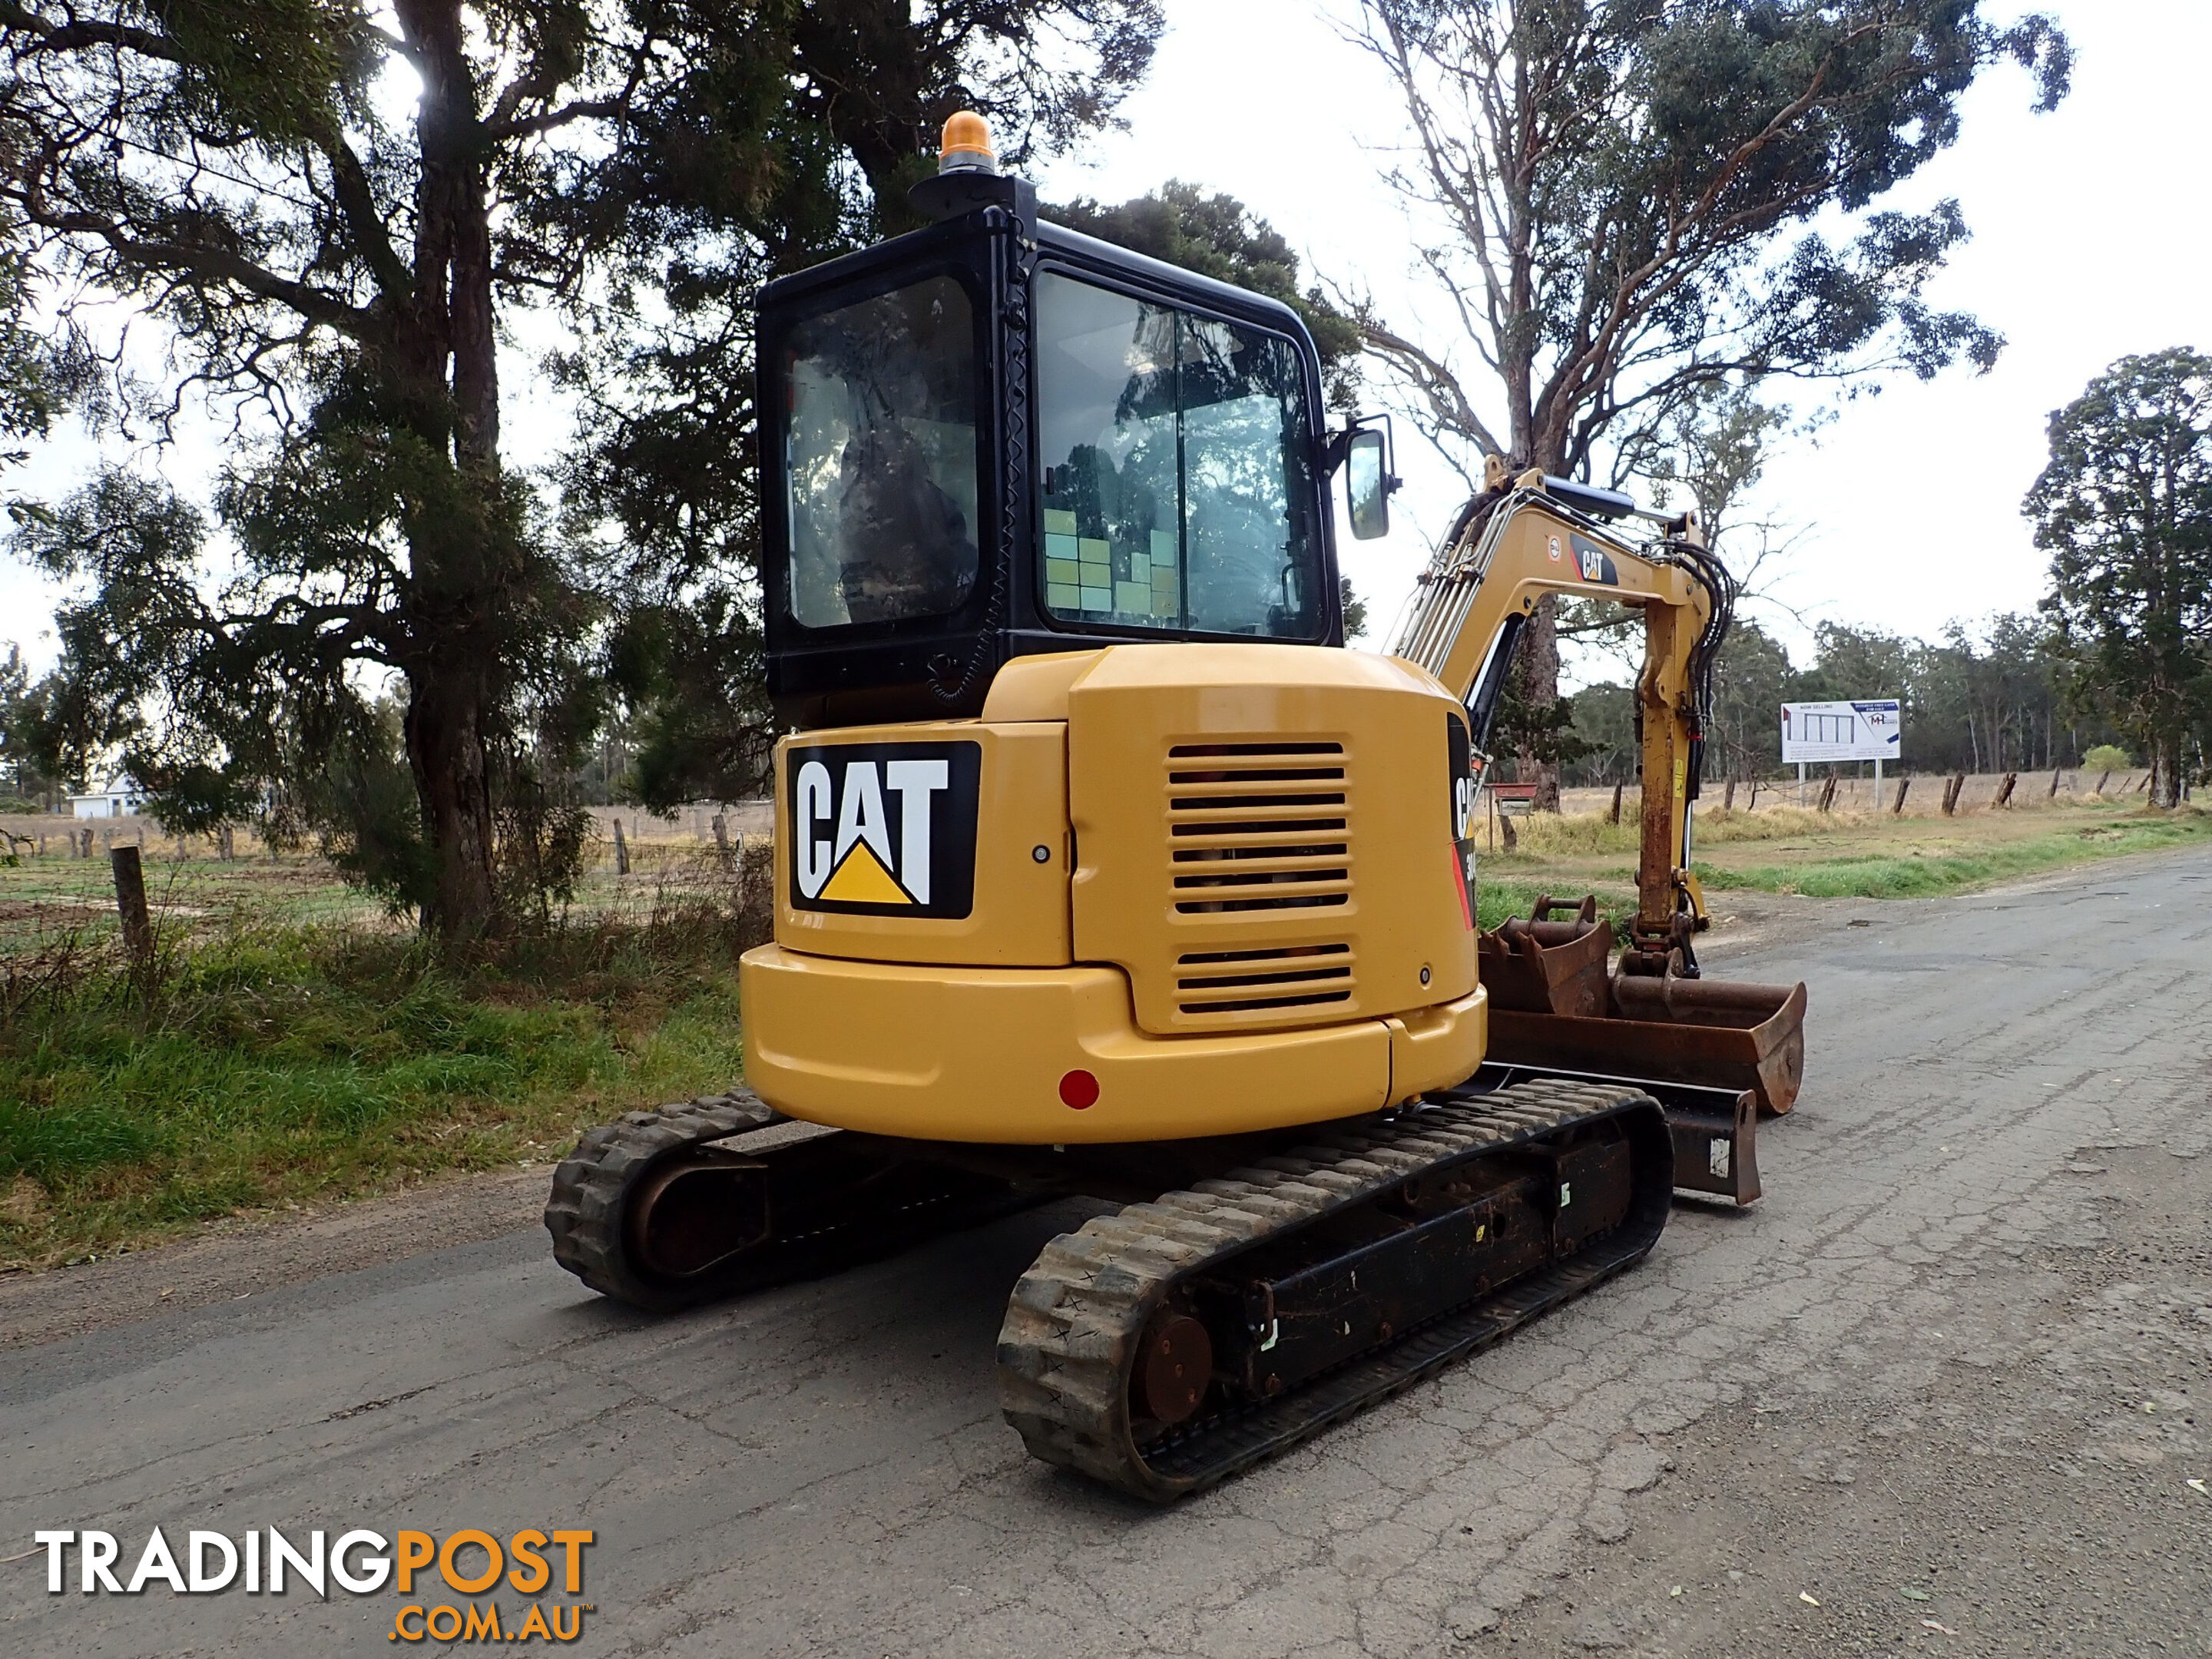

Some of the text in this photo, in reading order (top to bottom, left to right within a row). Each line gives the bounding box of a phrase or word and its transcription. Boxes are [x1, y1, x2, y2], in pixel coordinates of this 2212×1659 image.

[1582, 550, 1604, 581] CAT
[796, 760, 949, 905] CAT
[1456, 777, 1473, 840] CA
